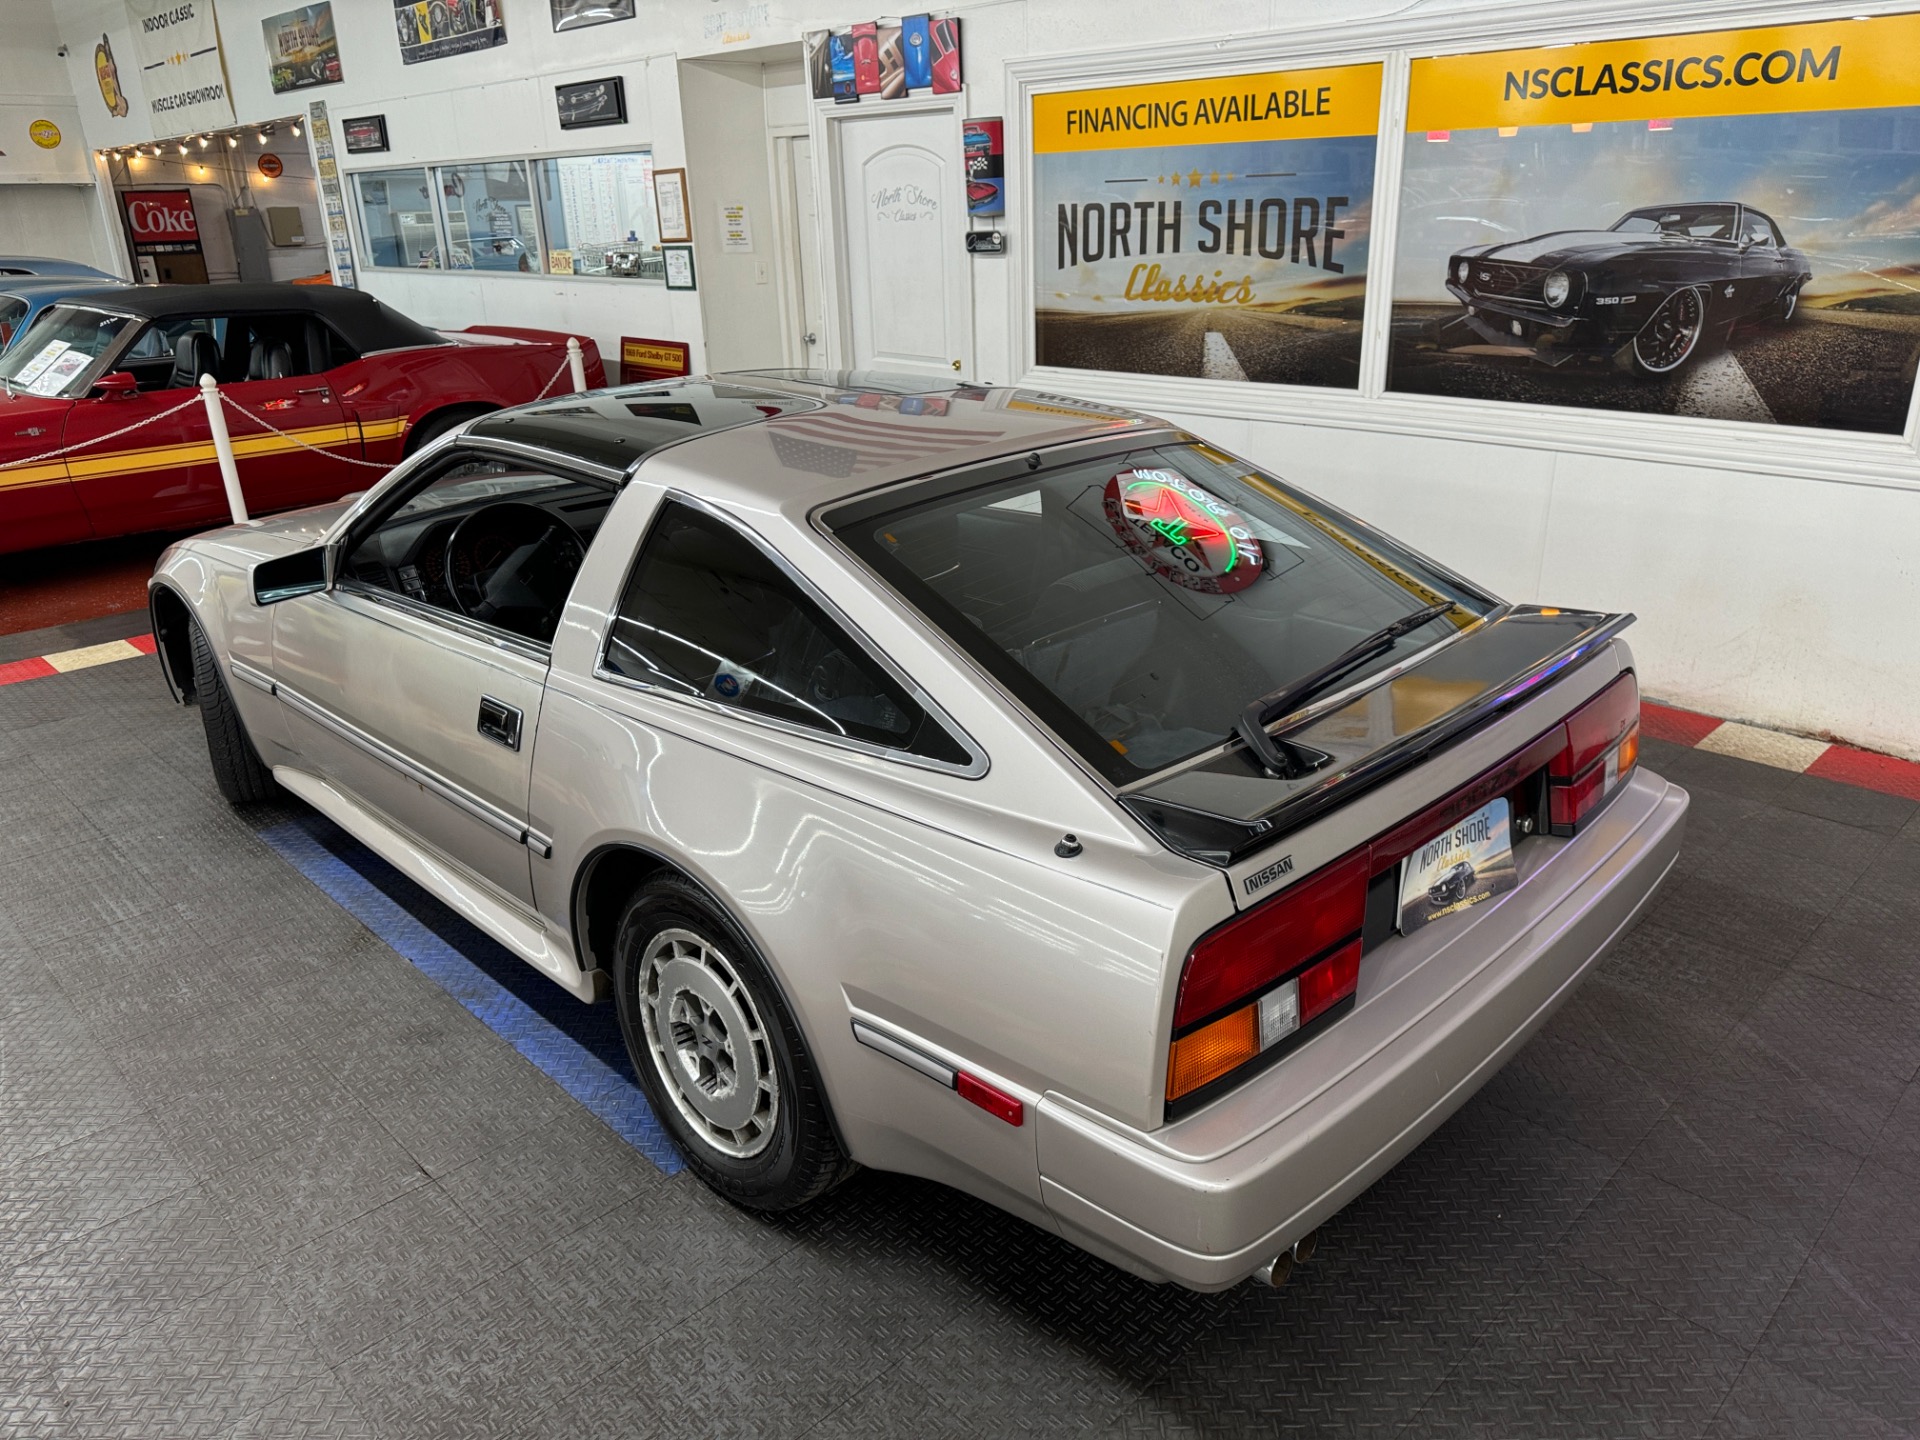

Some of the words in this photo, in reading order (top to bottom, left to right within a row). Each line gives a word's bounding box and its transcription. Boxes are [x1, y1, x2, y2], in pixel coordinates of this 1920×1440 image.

[142, 13, 169, 33] INDOOR
[169, 3, 194, 25] CLASSIC
[1503, 45, 1841, 101] NSCLASSICS.COM
[151, 96, 175, 114] MUSCLE
[174, 92, 188, 108] CAR
[187, 84, 225, 106] SHOWROOM
[1066, 99, 1189, 135] FINANCING
[1193, 86, 1332, 125] AVAILABLE
[871, 187, 902, 209] North
[903, 184, 938, 210] Shore
[128, 200, 196, 233] Coke
[1057, 200, 1182, 270] NORTH
[1197, 195, 1350, 275] SHORE
[1124, 263, 1257, 305] Classics
[1596, 296, 1619, 305] 350
[636, 349, 647, 358] Ford
[647, 350, 663, 362] Shelby
[1420, 833, 1452, 874] NORTH
[1455, 816, 1492, 847] SHORE
[1436, 848, 1473, 872] Classics
[1248, 858, 1294, 891] NISSAN
[1427, 891, 1492, 921] www.nsclassics.com
